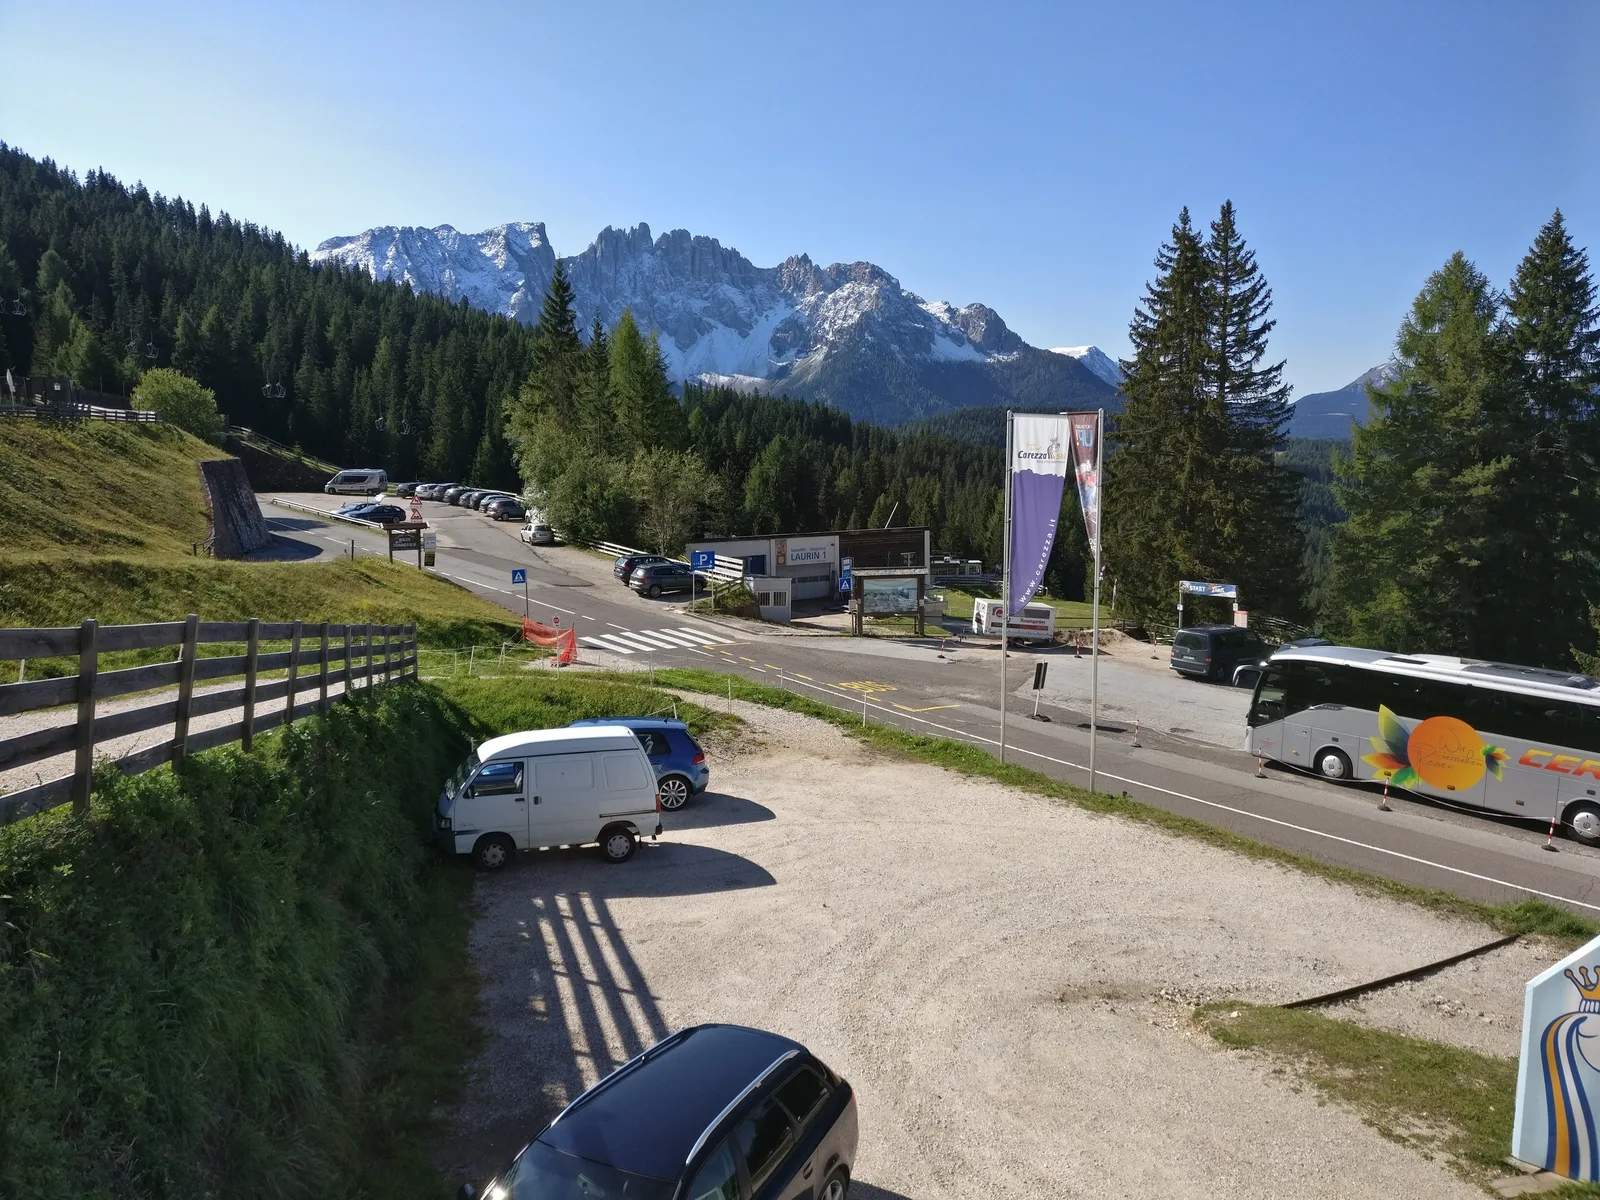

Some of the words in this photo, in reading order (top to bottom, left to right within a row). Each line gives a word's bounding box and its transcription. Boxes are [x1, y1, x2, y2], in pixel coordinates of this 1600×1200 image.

[1017, 450, 1047, 460] Carezza
[700, 554, 708, 565] P
[791, 552, 820, 561] LAURIN
